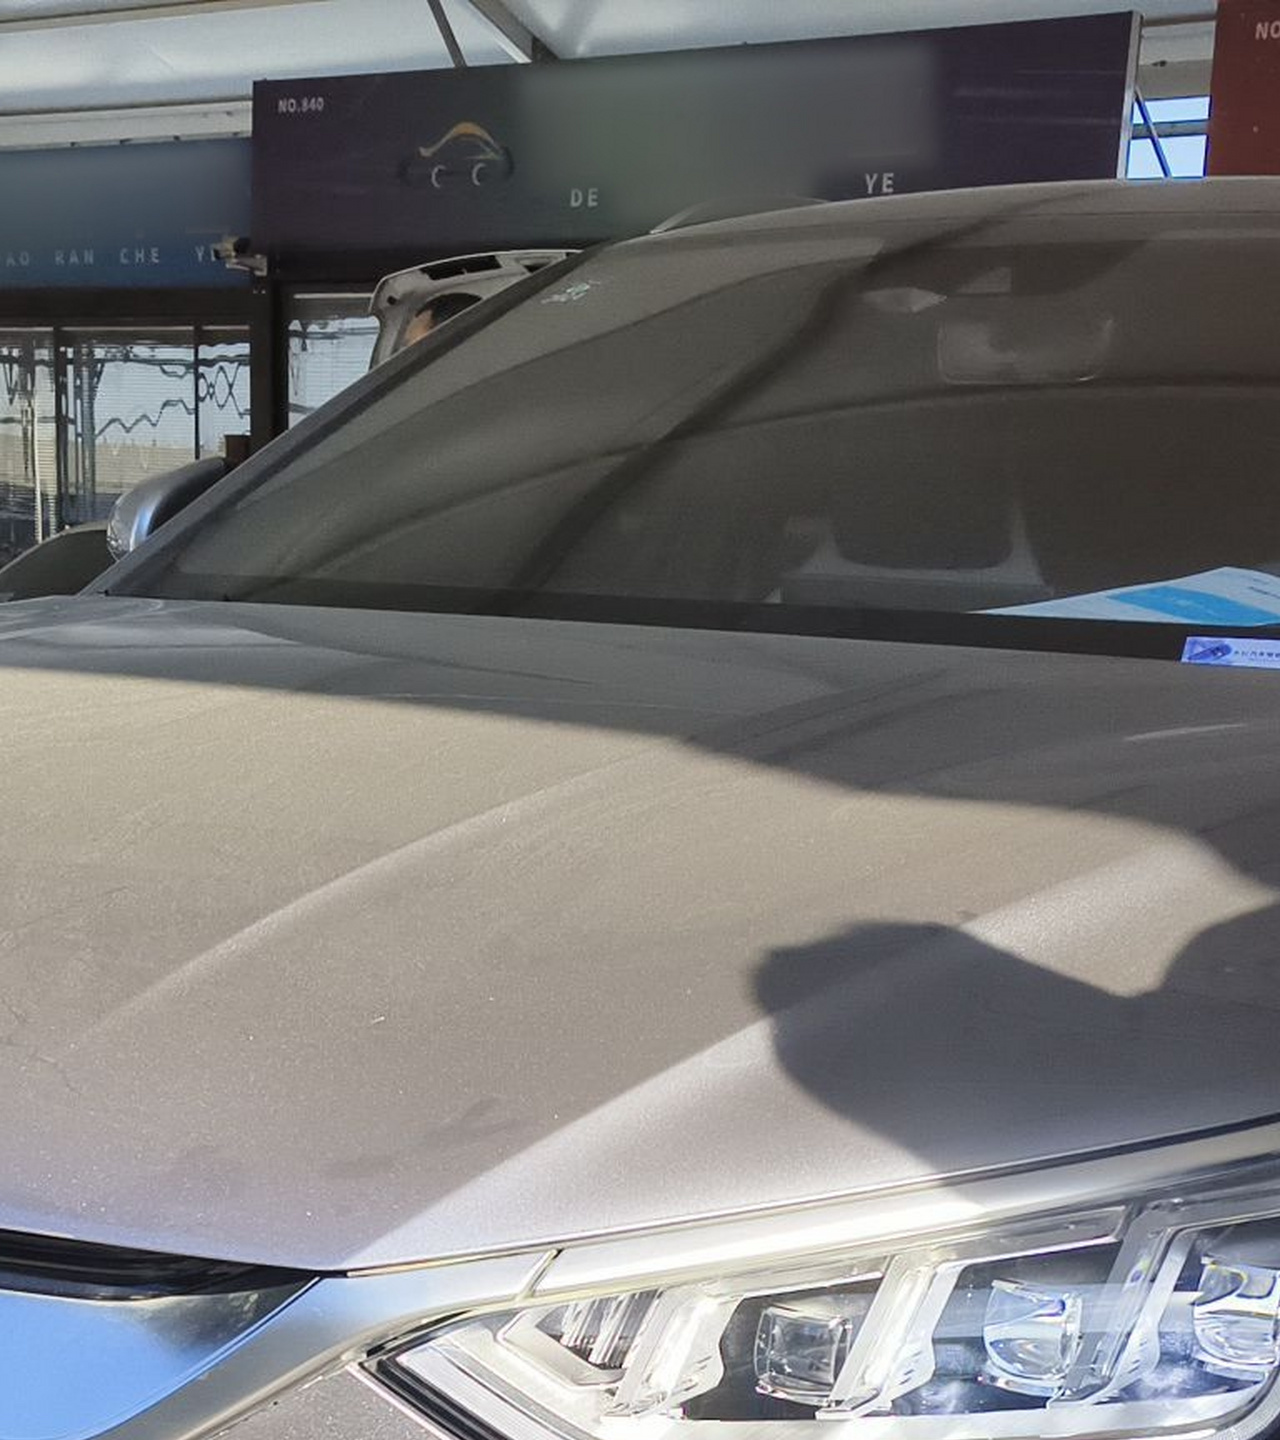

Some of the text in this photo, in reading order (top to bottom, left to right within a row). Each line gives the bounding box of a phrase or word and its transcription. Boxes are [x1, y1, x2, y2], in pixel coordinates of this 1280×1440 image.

[570, 172, 894, 208] DE YE
[54, 249, 94, 266] RAN
[119, 247, 159, 264] CHE
